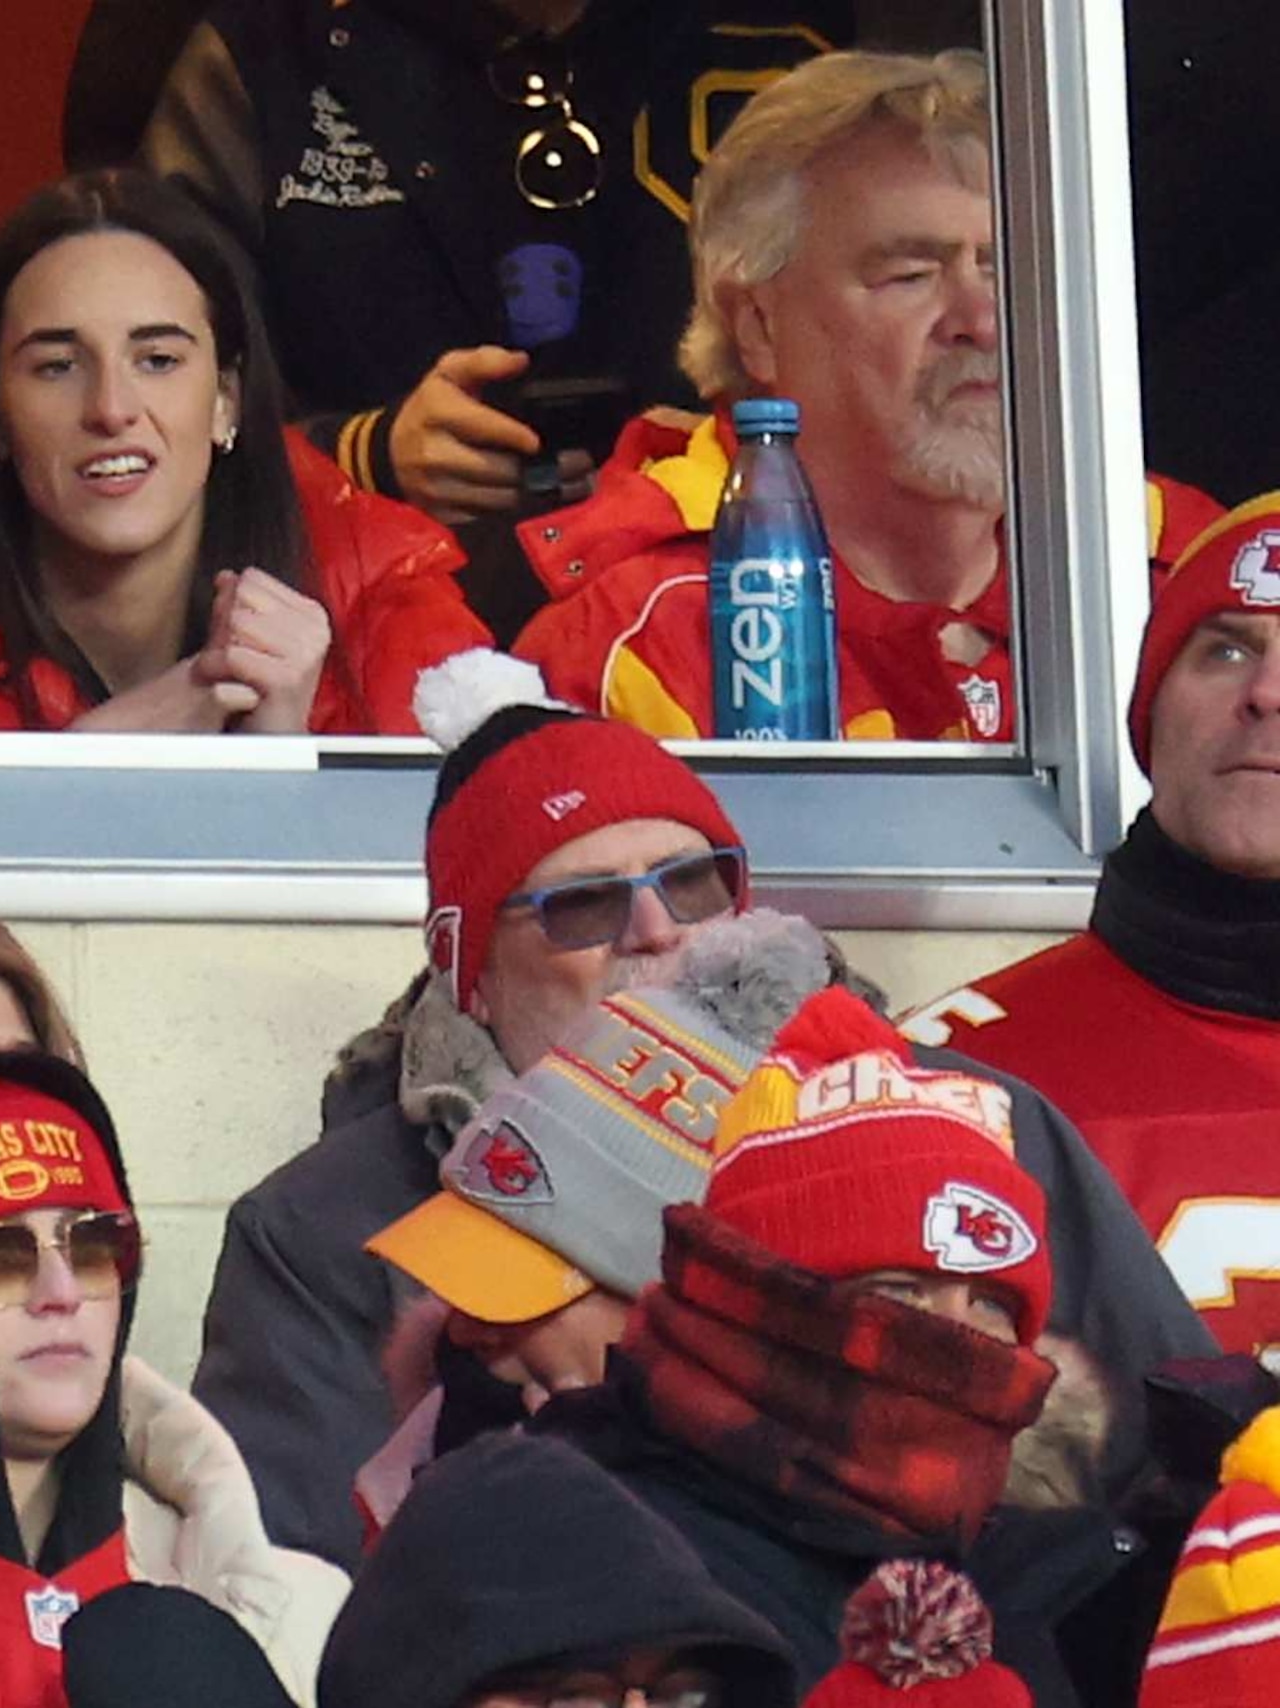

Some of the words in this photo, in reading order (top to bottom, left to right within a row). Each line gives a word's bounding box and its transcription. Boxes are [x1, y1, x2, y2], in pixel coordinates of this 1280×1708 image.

[730, 558, 783, 709] zen
[23, 1119, 83, 1162] CITY
[953, 1203, 1014, 1258] KC
